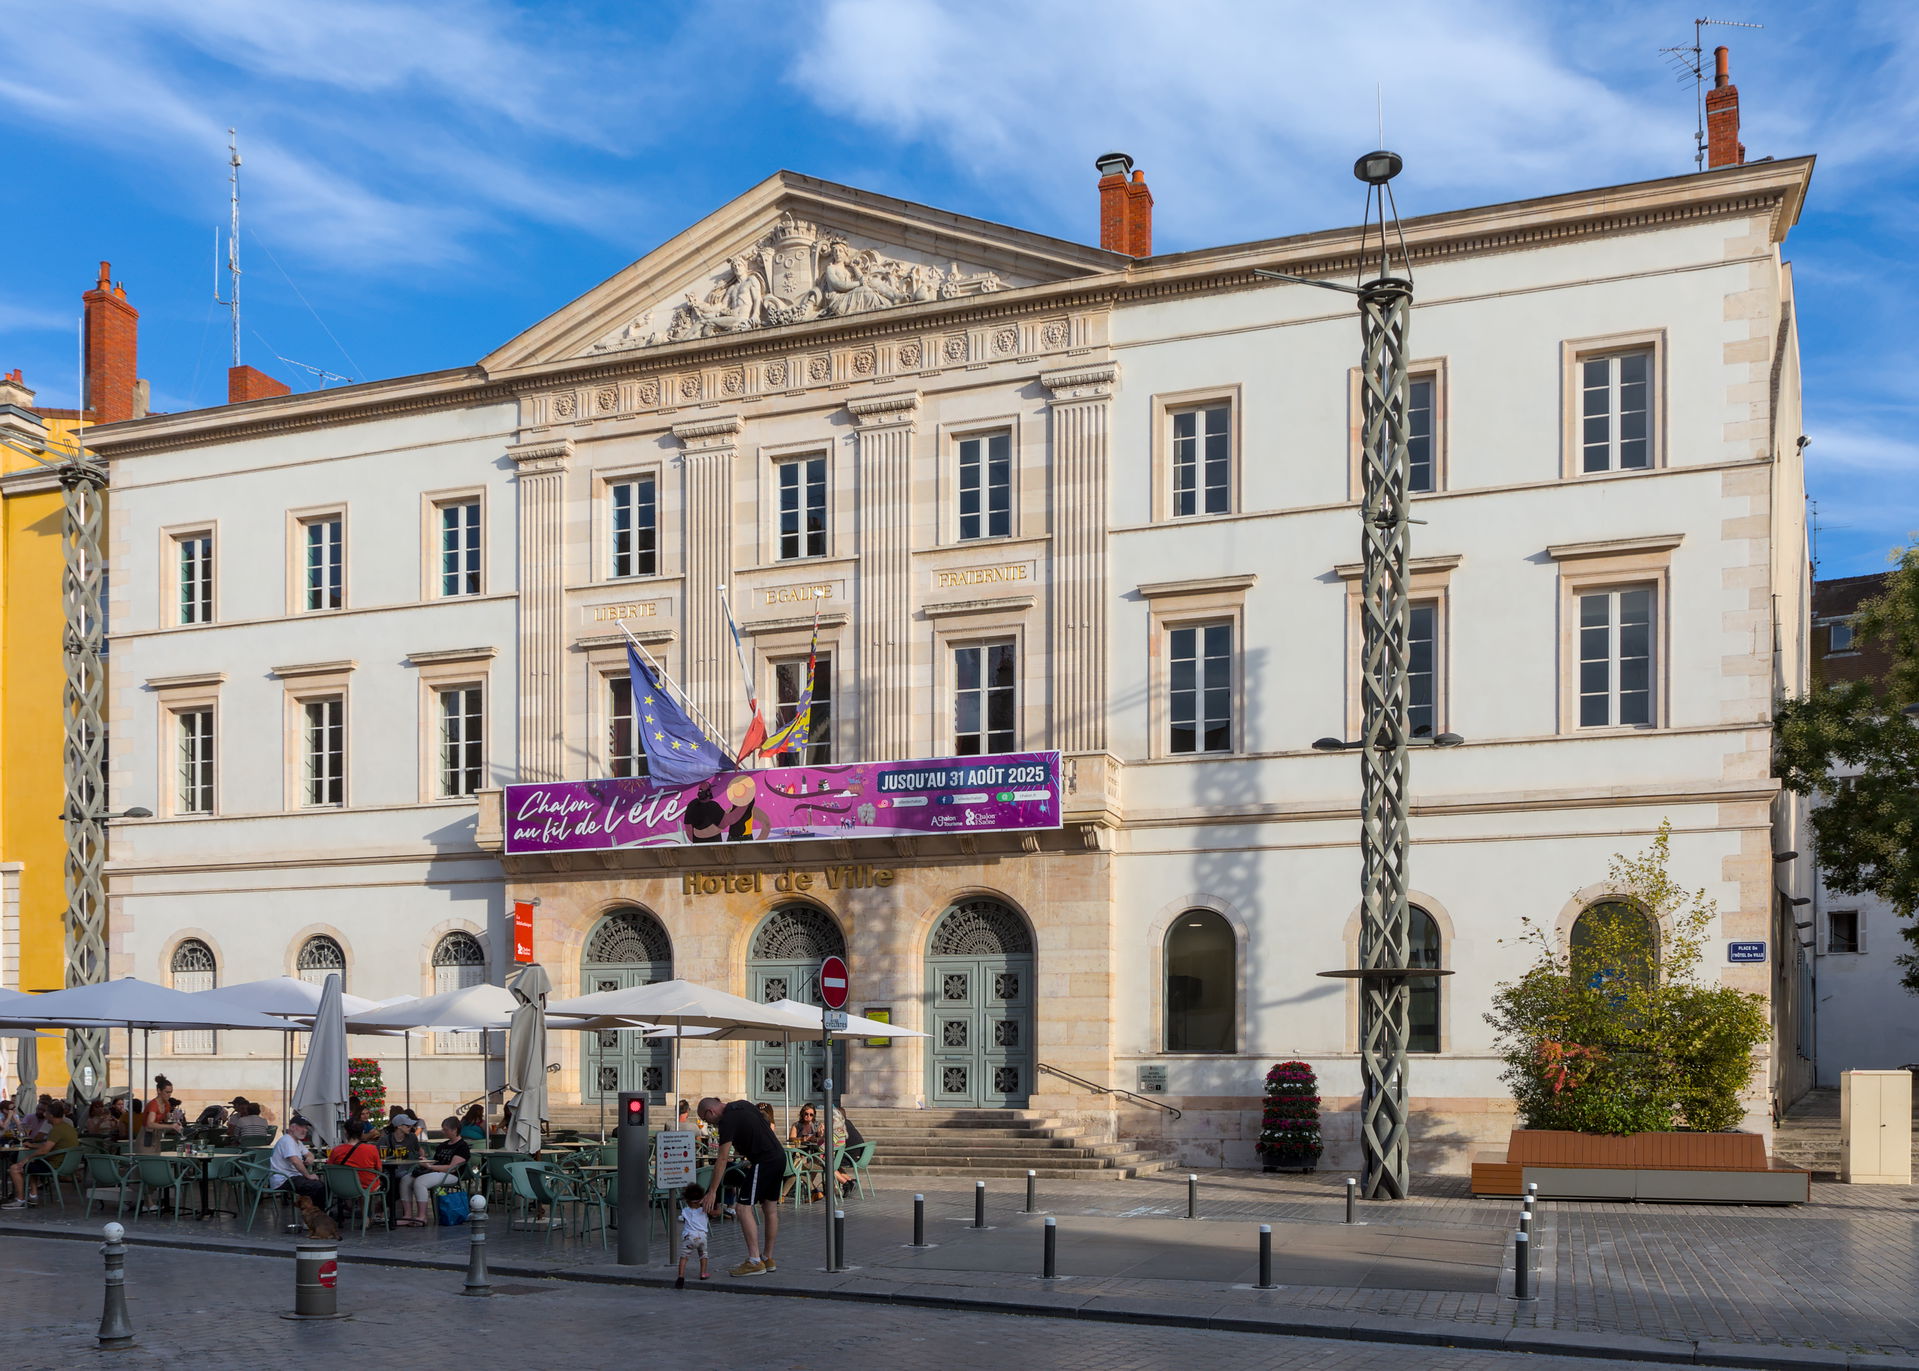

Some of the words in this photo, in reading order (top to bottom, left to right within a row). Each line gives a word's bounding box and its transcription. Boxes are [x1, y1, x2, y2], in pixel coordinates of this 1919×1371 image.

[939, 565, 1027, 587] FRATERNITE
[594, 603, 656, 621] LIBERTE
[881, 771, 946, 791] JUSQU'AU
[950, 770, 964, 787] 31
[967, 766, 1005, 786] AOÛT
[1008, 766, 1045, 784] 2025
[513, 826, 542, 840] au
[542, 816, 572, 843] fil
[575, 812, 602, 836] de
[604, 788, 688, 834] l'été
[516, 791, 594, 821] Chalon
[775, 867, 814, 892] de
[824, 864, 895, 890] Ville
